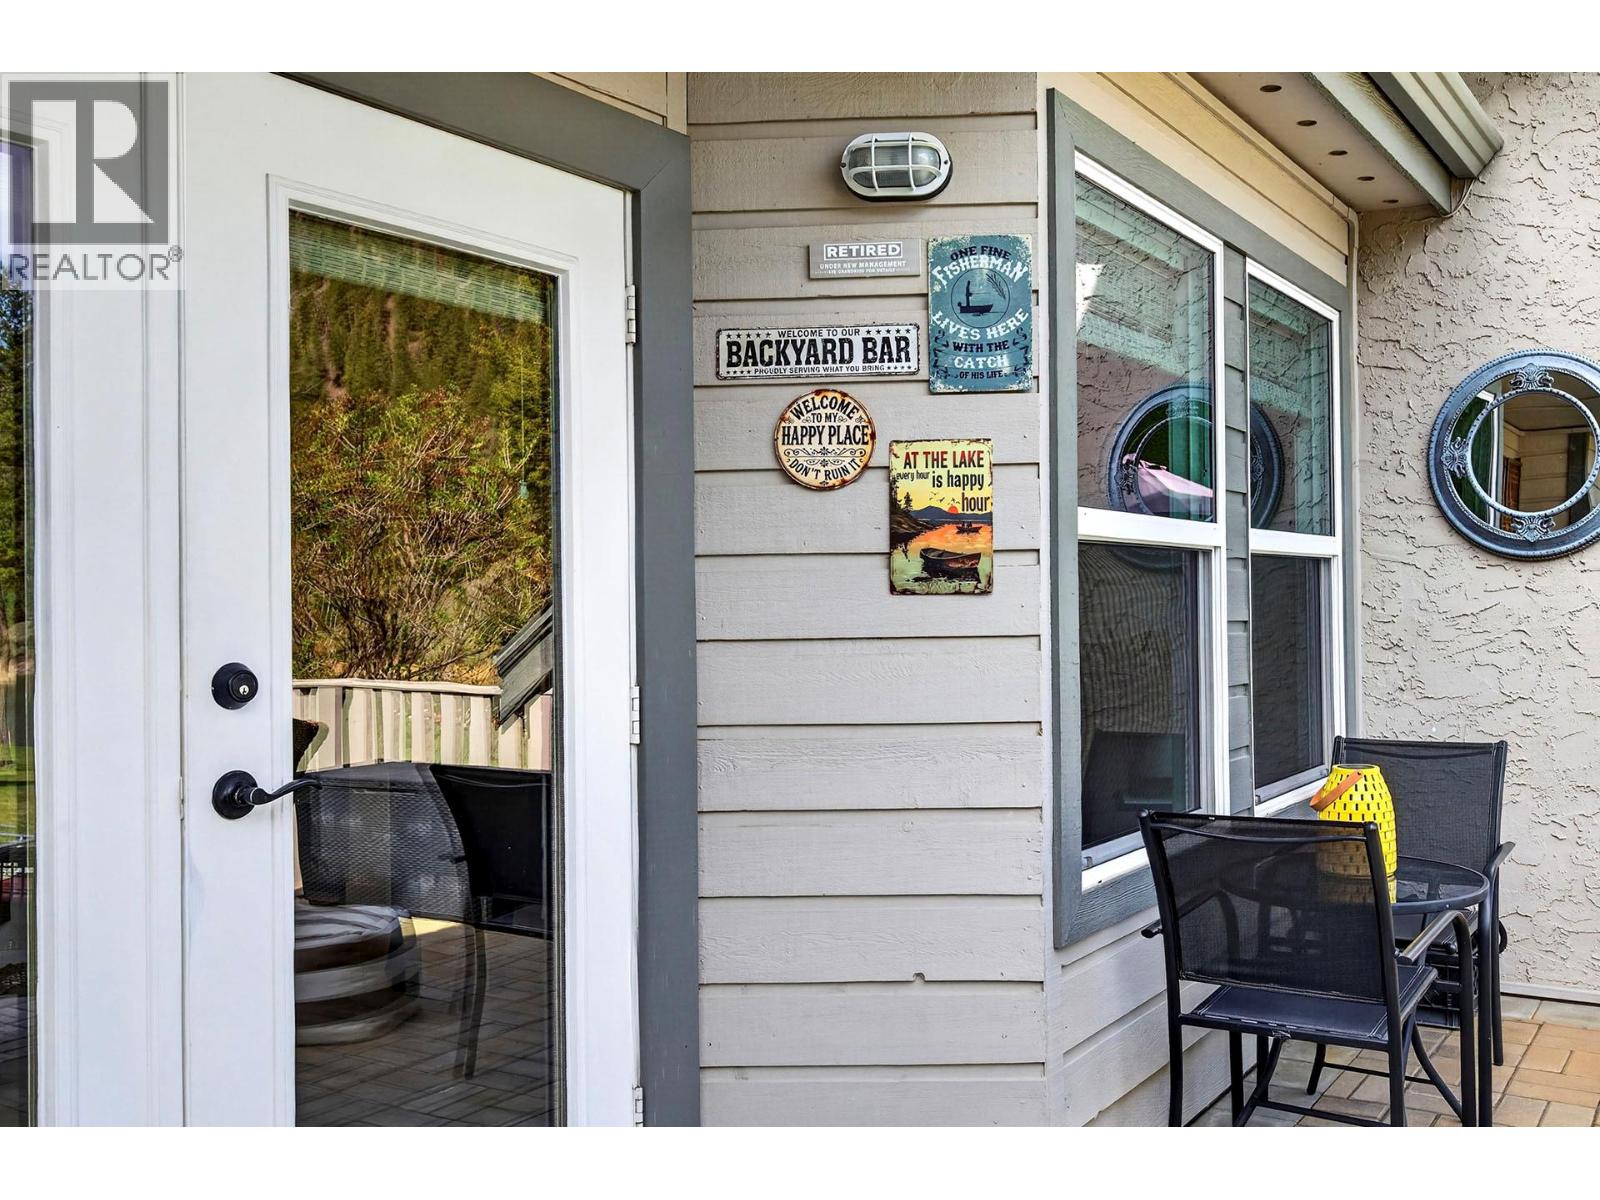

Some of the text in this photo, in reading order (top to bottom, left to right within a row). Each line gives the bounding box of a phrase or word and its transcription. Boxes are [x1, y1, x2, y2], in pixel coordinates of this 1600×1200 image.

[827, 244, 900, 258] RETIRED
[950, 245, 1012, 261] ONE FINE
[859, 260, 907, 268] MANAGEMENT
[932, 254, 1028, 286] FISHERMAN
[777, 328, 861, 338] WELCOME TO OUR
[931, 308, 1029, 340] LIVES HERE
[726, 335, 911, 368] BACKYARD BAR
[952, 340, 1010, 353] WITH THE
[754, 367, 787, 375] PROUDLY
[789, 366, 821, 374] SERVING
[953, 354, 1010, 369] CATCH
[959, 370, 1004, 379] OF HIS LIFE
[790, 395, 859, 420] WELCOME
[811, 412, 839, 423] TO MY
[781, 424, 870, 446] HAPPY PLACE
[903, 450, 985, 470] AT THE LAKE
[788, 458, 861, 481] DON'T RUIN IT
[896, 470, 985, 491] every hour is happy
[961, 492, 991, 512] hour
